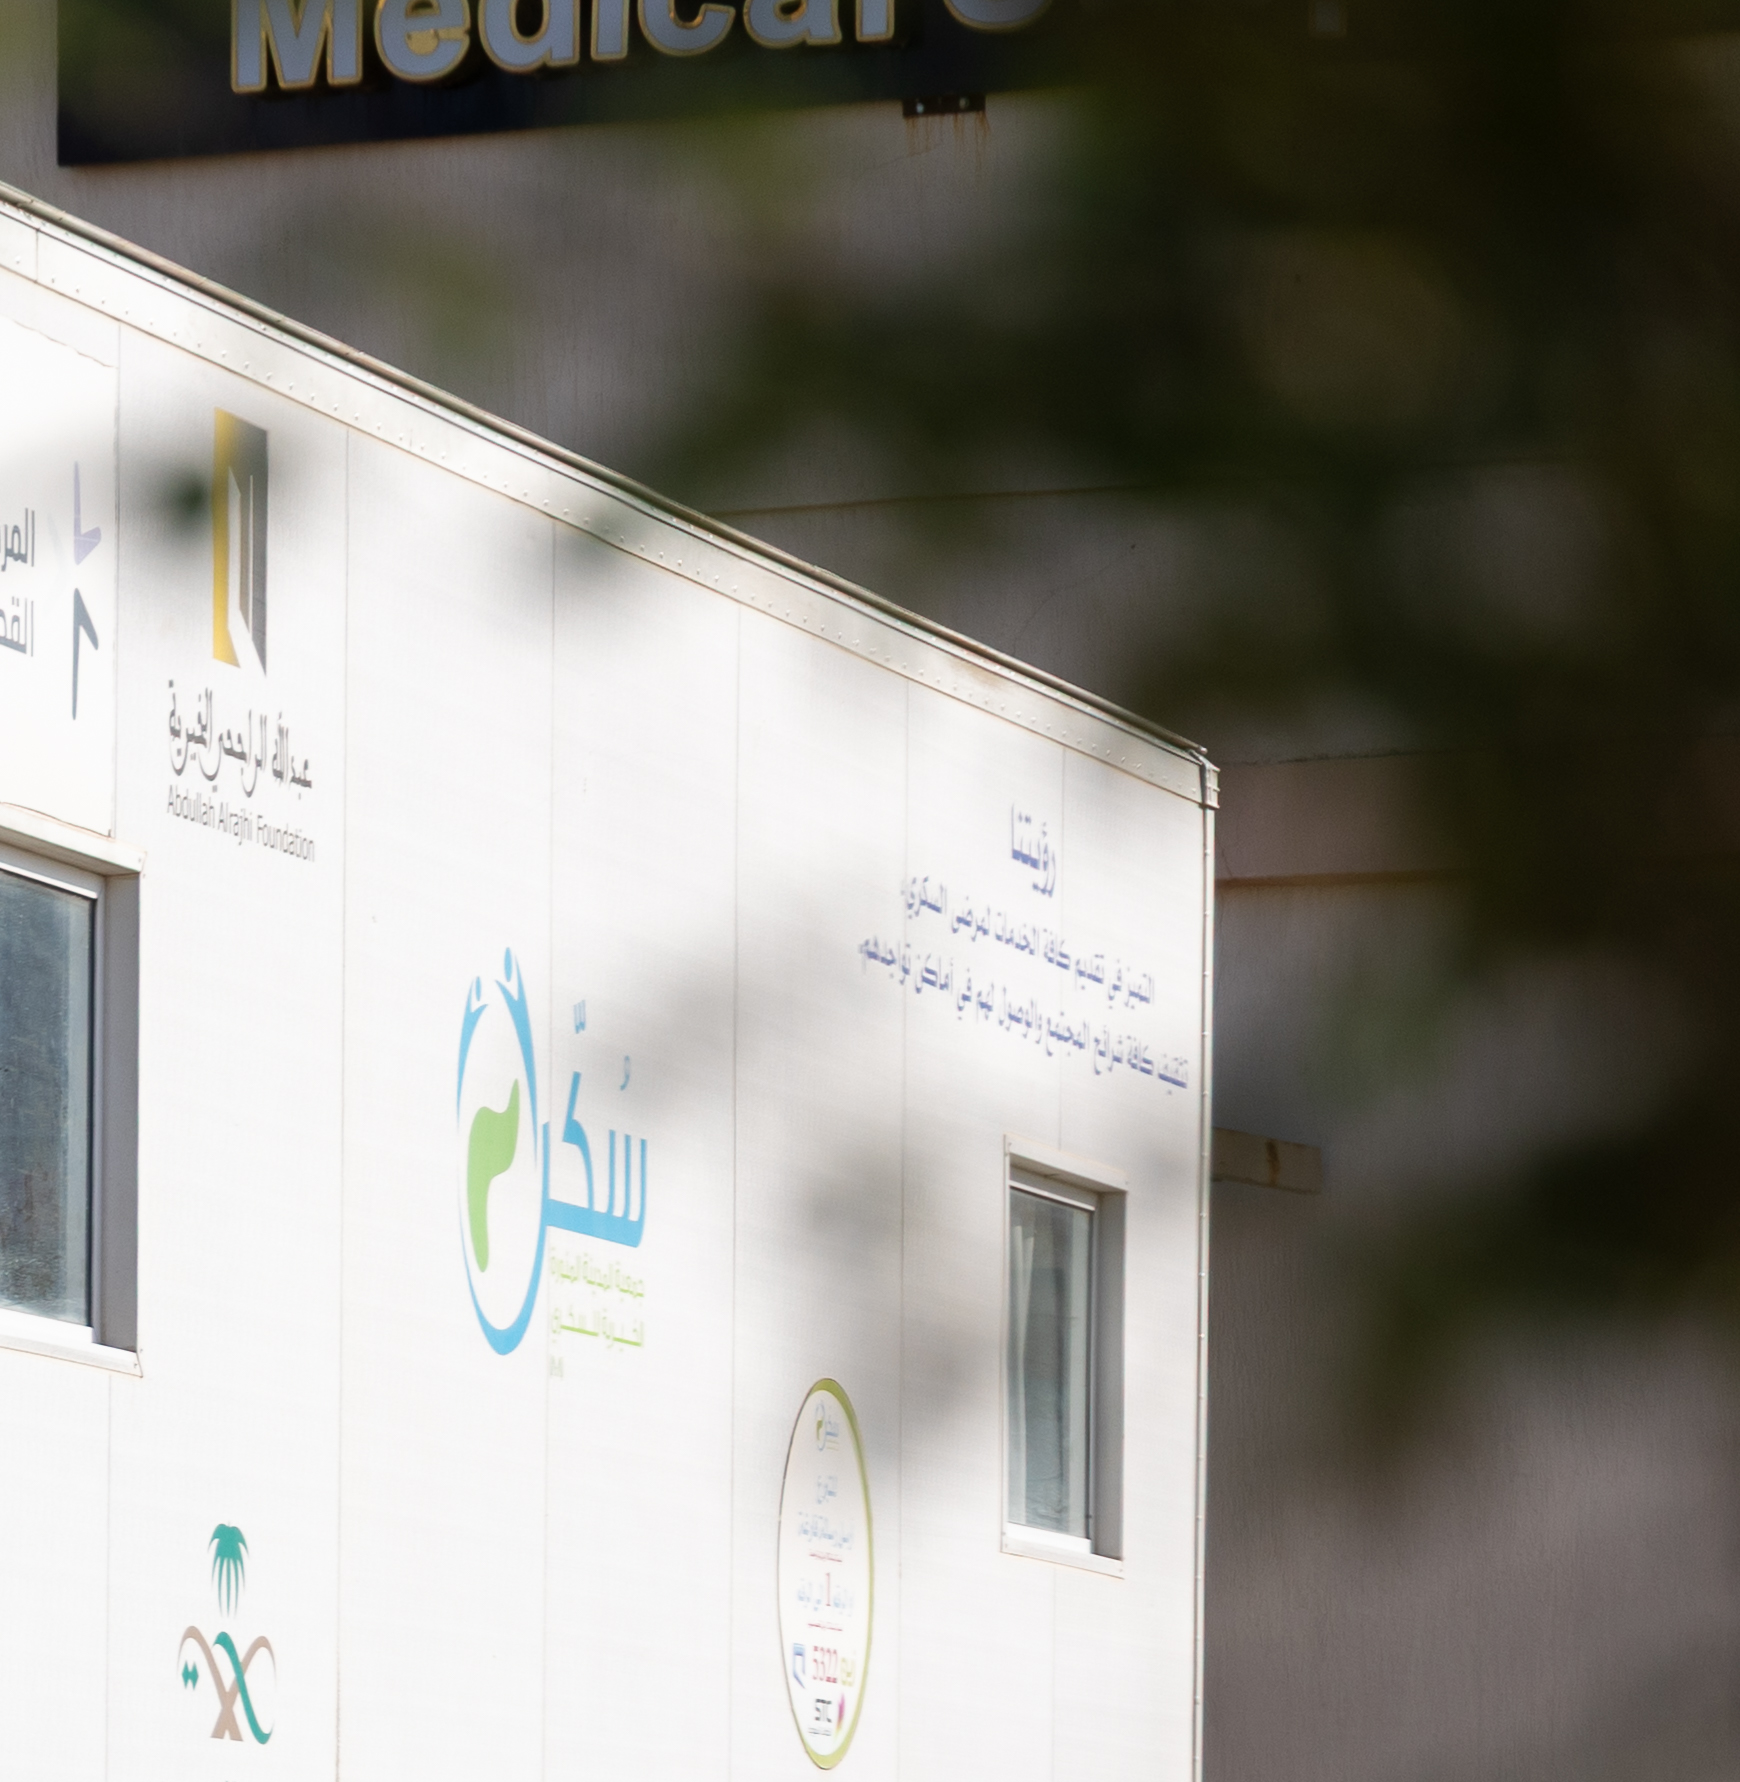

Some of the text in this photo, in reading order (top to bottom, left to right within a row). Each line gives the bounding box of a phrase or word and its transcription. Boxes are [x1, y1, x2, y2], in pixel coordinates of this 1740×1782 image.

[167, 785, 315, 862] Abdullah Alrajhi Foundation
